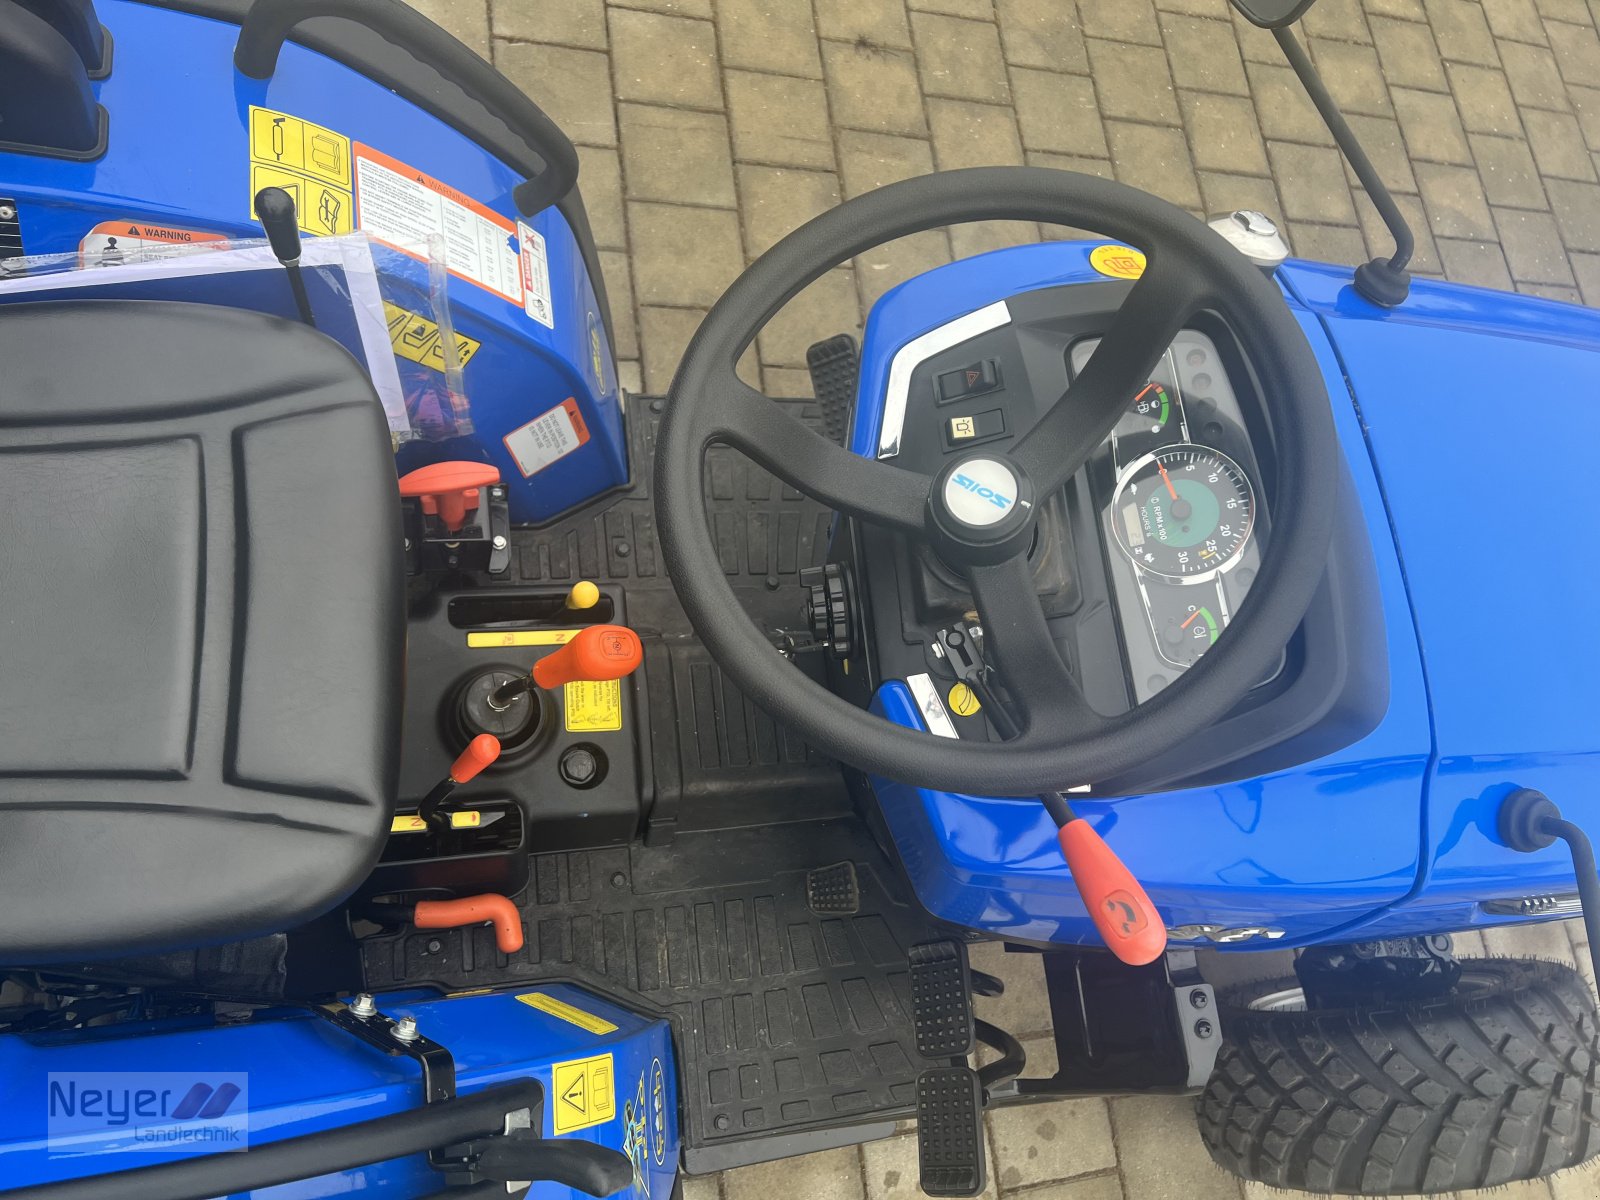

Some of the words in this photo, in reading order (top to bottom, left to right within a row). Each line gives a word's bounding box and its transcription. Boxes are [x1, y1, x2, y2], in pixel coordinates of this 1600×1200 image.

[144, 228, 191, 242] WARNING
[1207, 473, 1219, 484] 10
[952, 473, 1012, 509] SOLIS
[1226, 498, 1238, 509] 15
[1140, 506, 1152, 531] HOURS
[1219, 524, 1232, 537] 20
[1205, 540, 1218, 552] 25
[1177, 551, 1189, 564] 30
[556, 634, 565, 642] N
[411, 817, 421, 827] N
